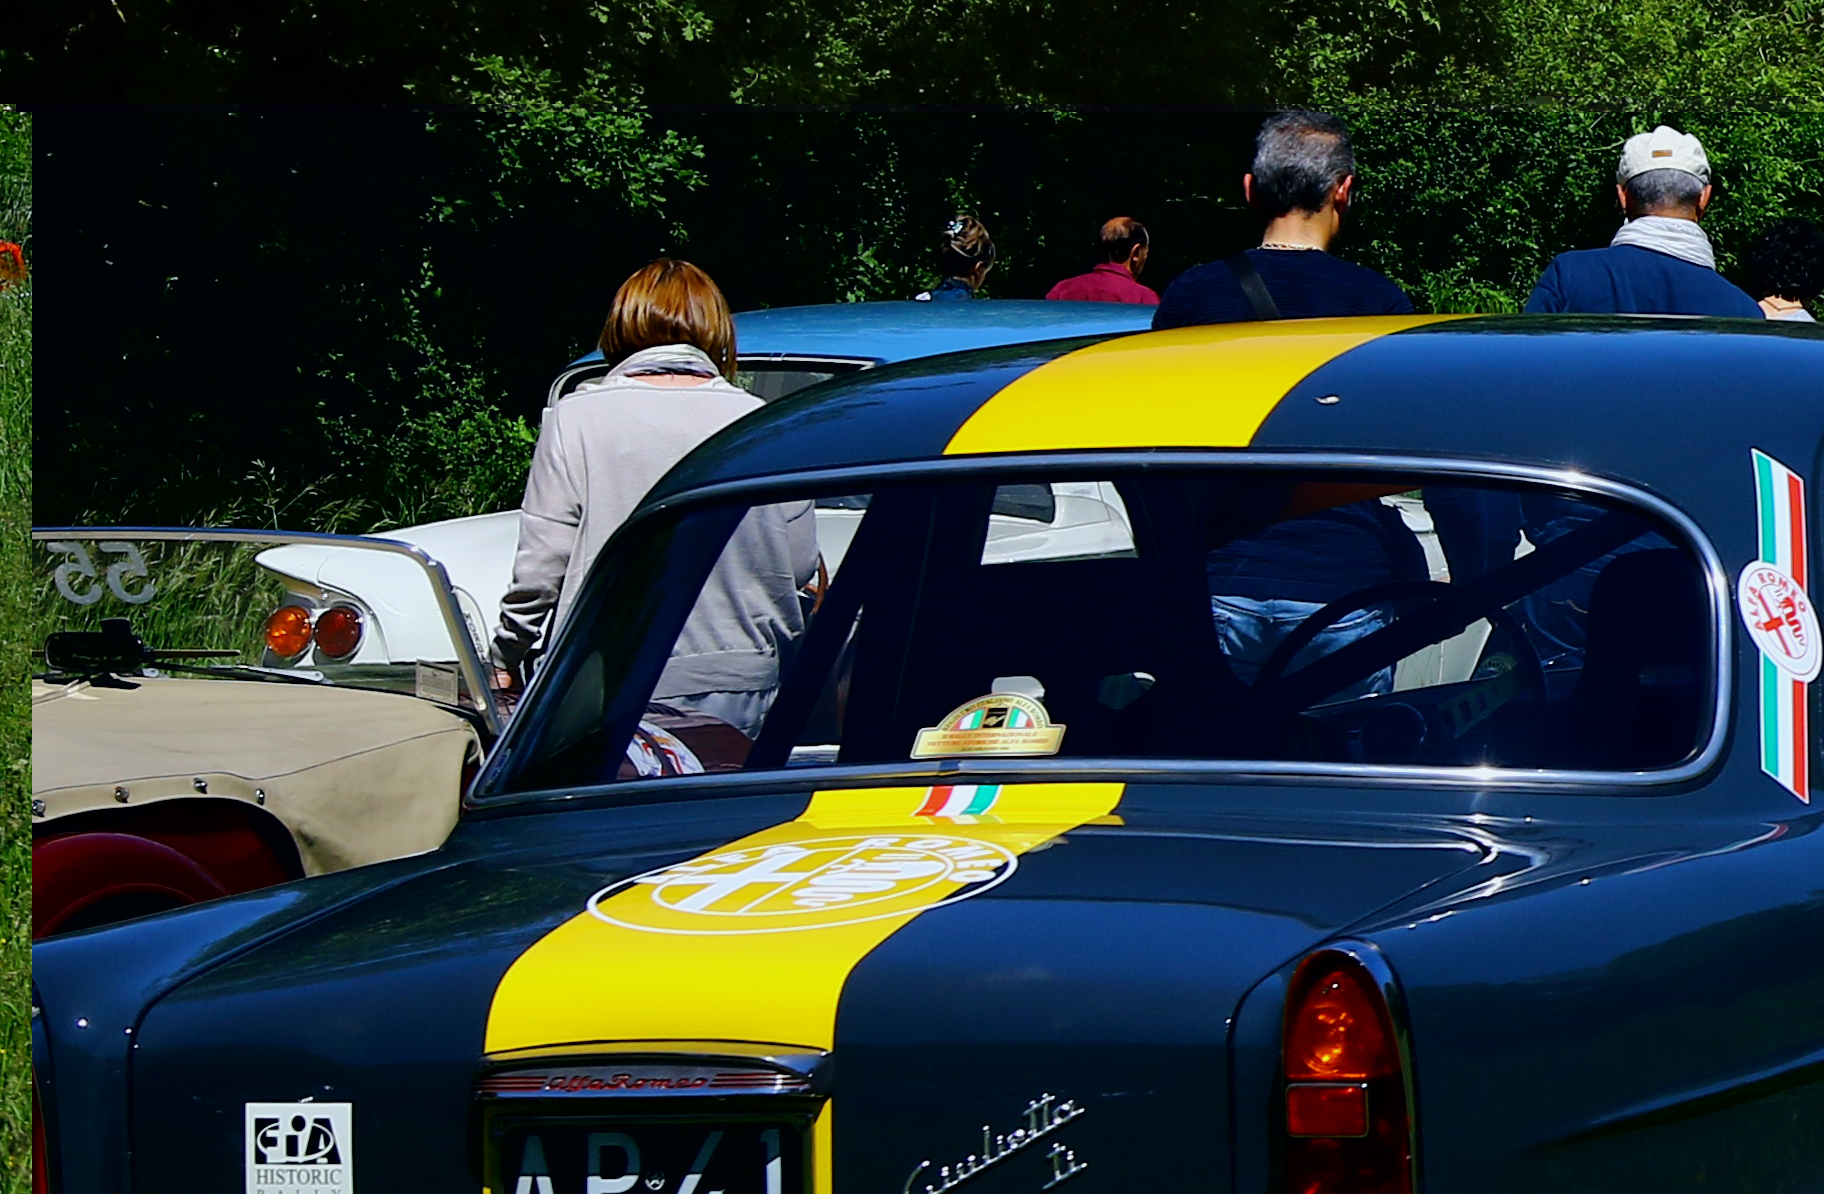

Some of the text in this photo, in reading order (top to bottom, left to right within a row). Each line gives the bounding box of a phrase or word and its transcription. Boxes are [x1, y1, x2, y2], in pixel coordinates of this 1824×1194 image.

[1747, 571, 1807, 631] ALFA ROMEO
[856, 837, 998, 883] ROMEO
[255, 1168, 343, 1185] HISTORIC
